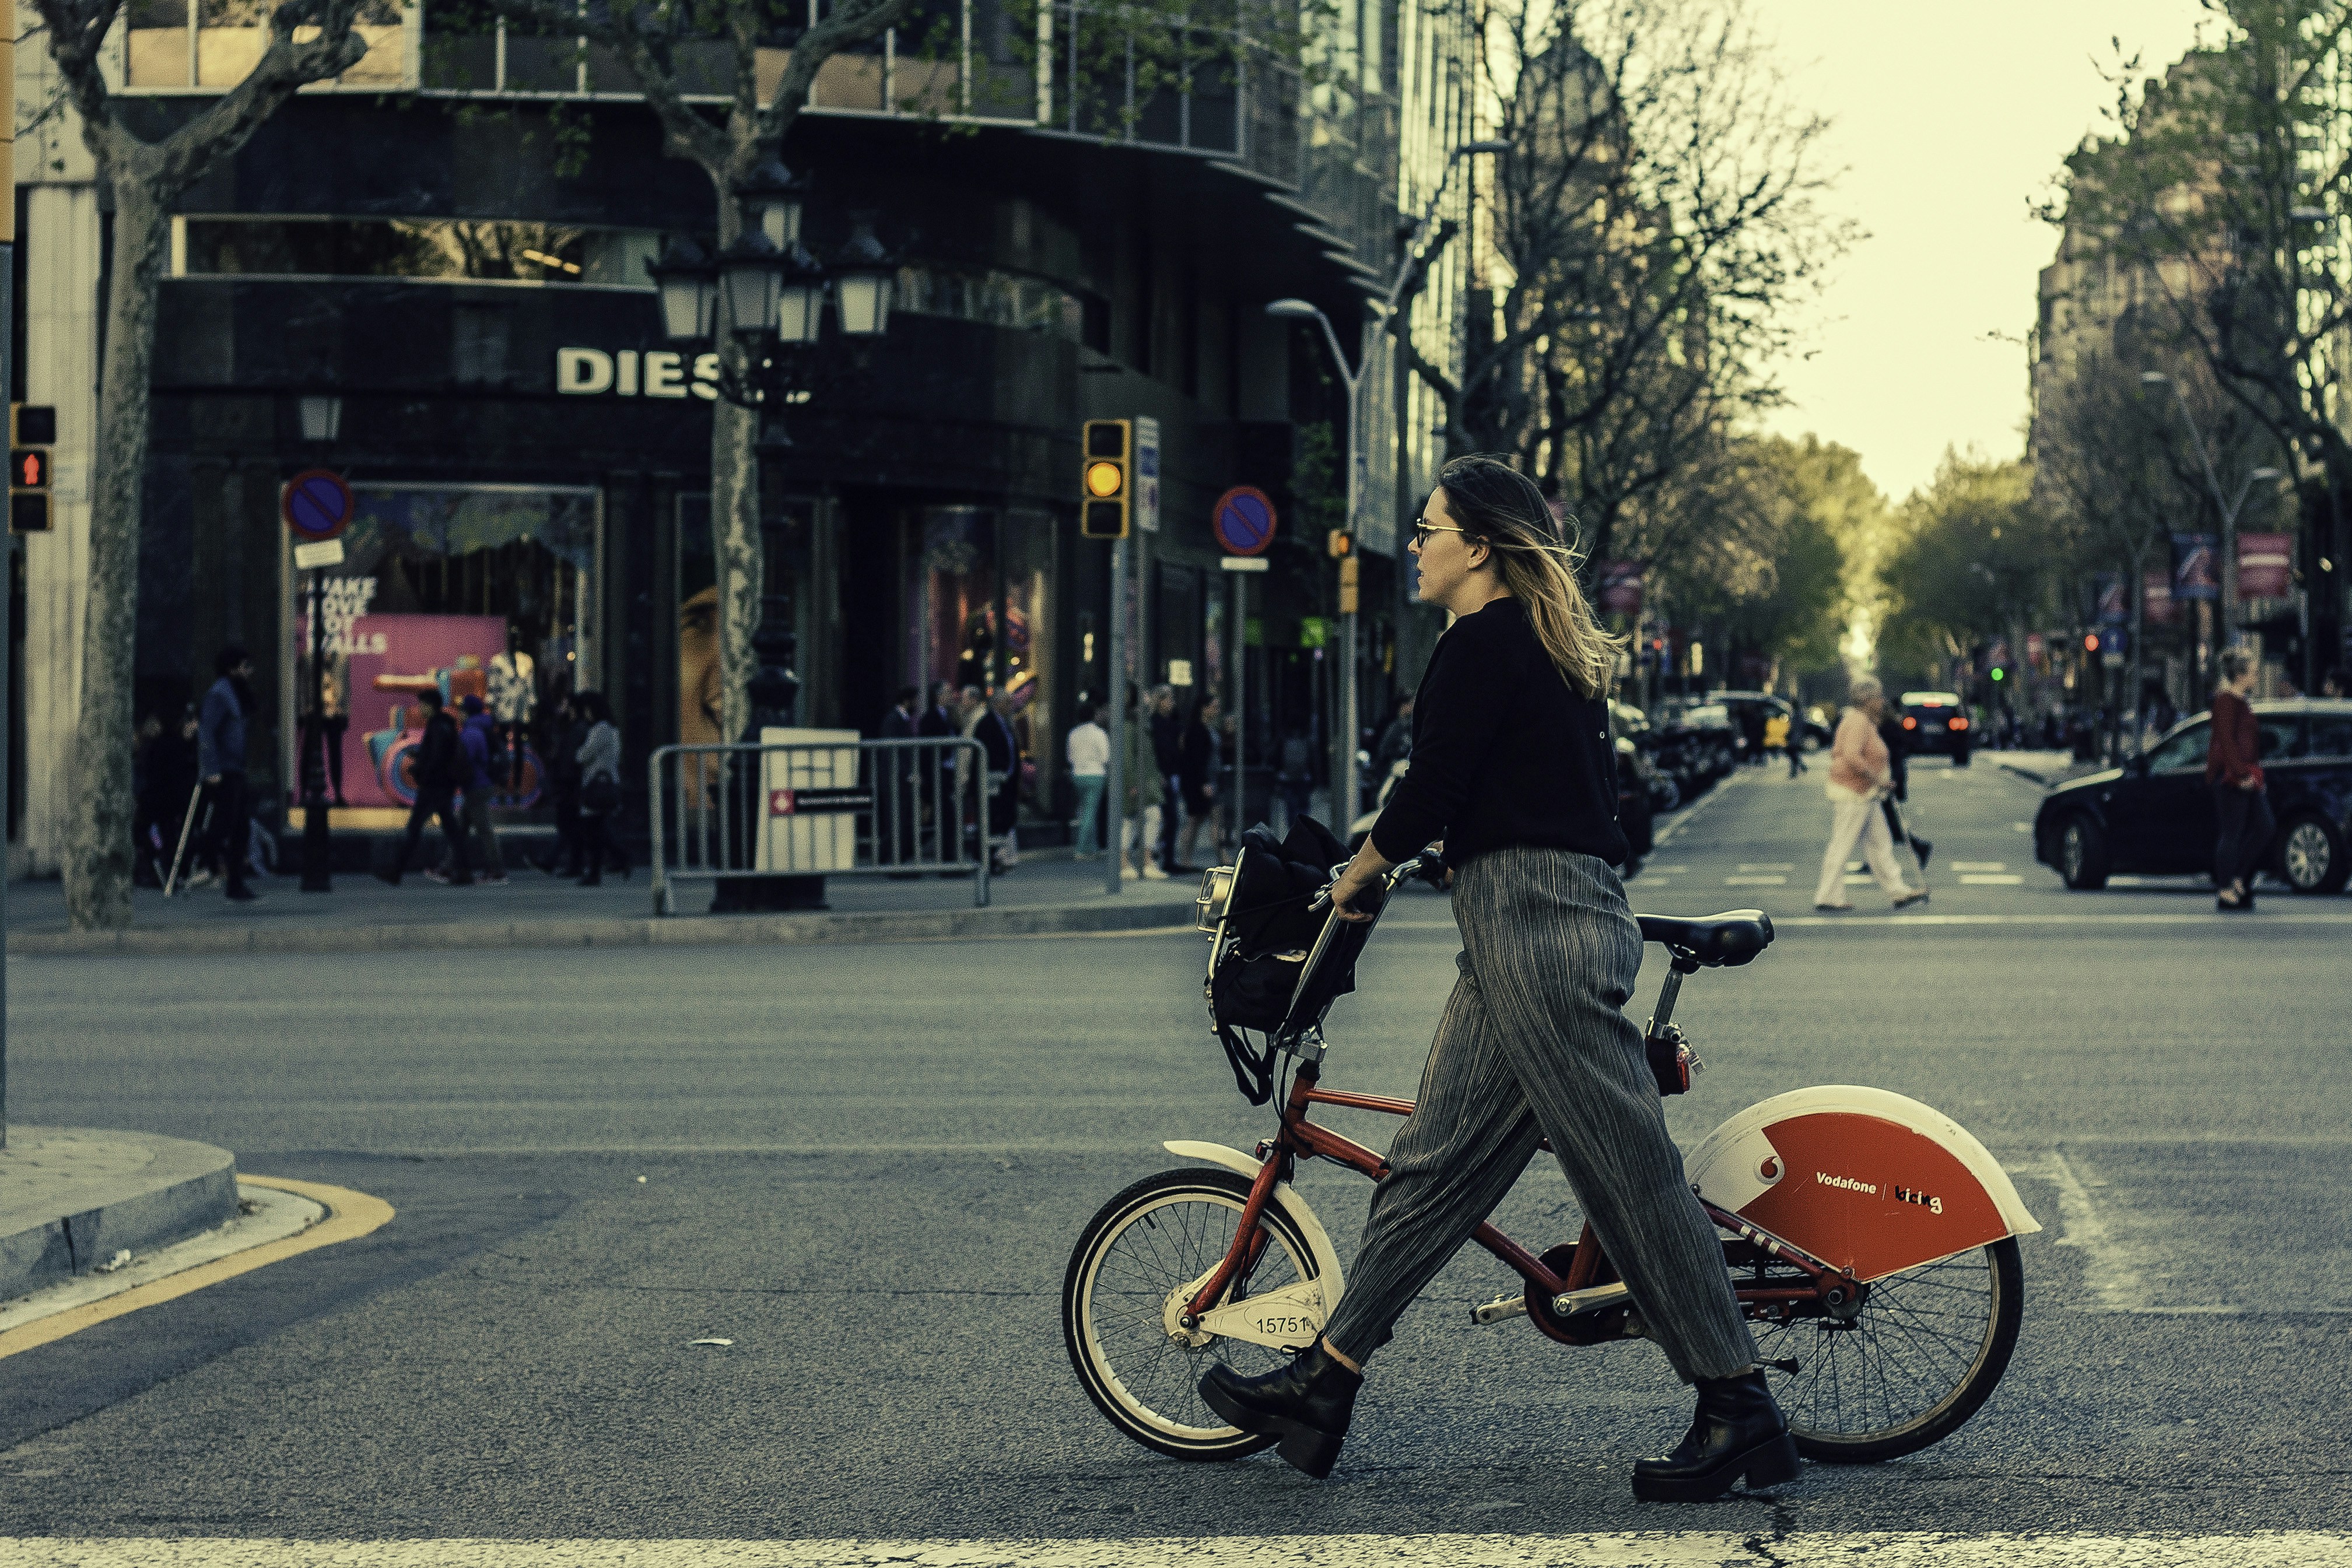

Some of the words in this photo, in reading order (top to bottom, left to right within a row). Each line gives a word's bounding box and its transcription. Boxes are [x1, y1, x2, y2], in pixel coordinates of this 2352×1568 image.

[1816, 1171, 1877, 1194] Vodafone
[1895, 1185, 1943, 1215] bicing
[1257, 1316, 1307, 1334] 15751
